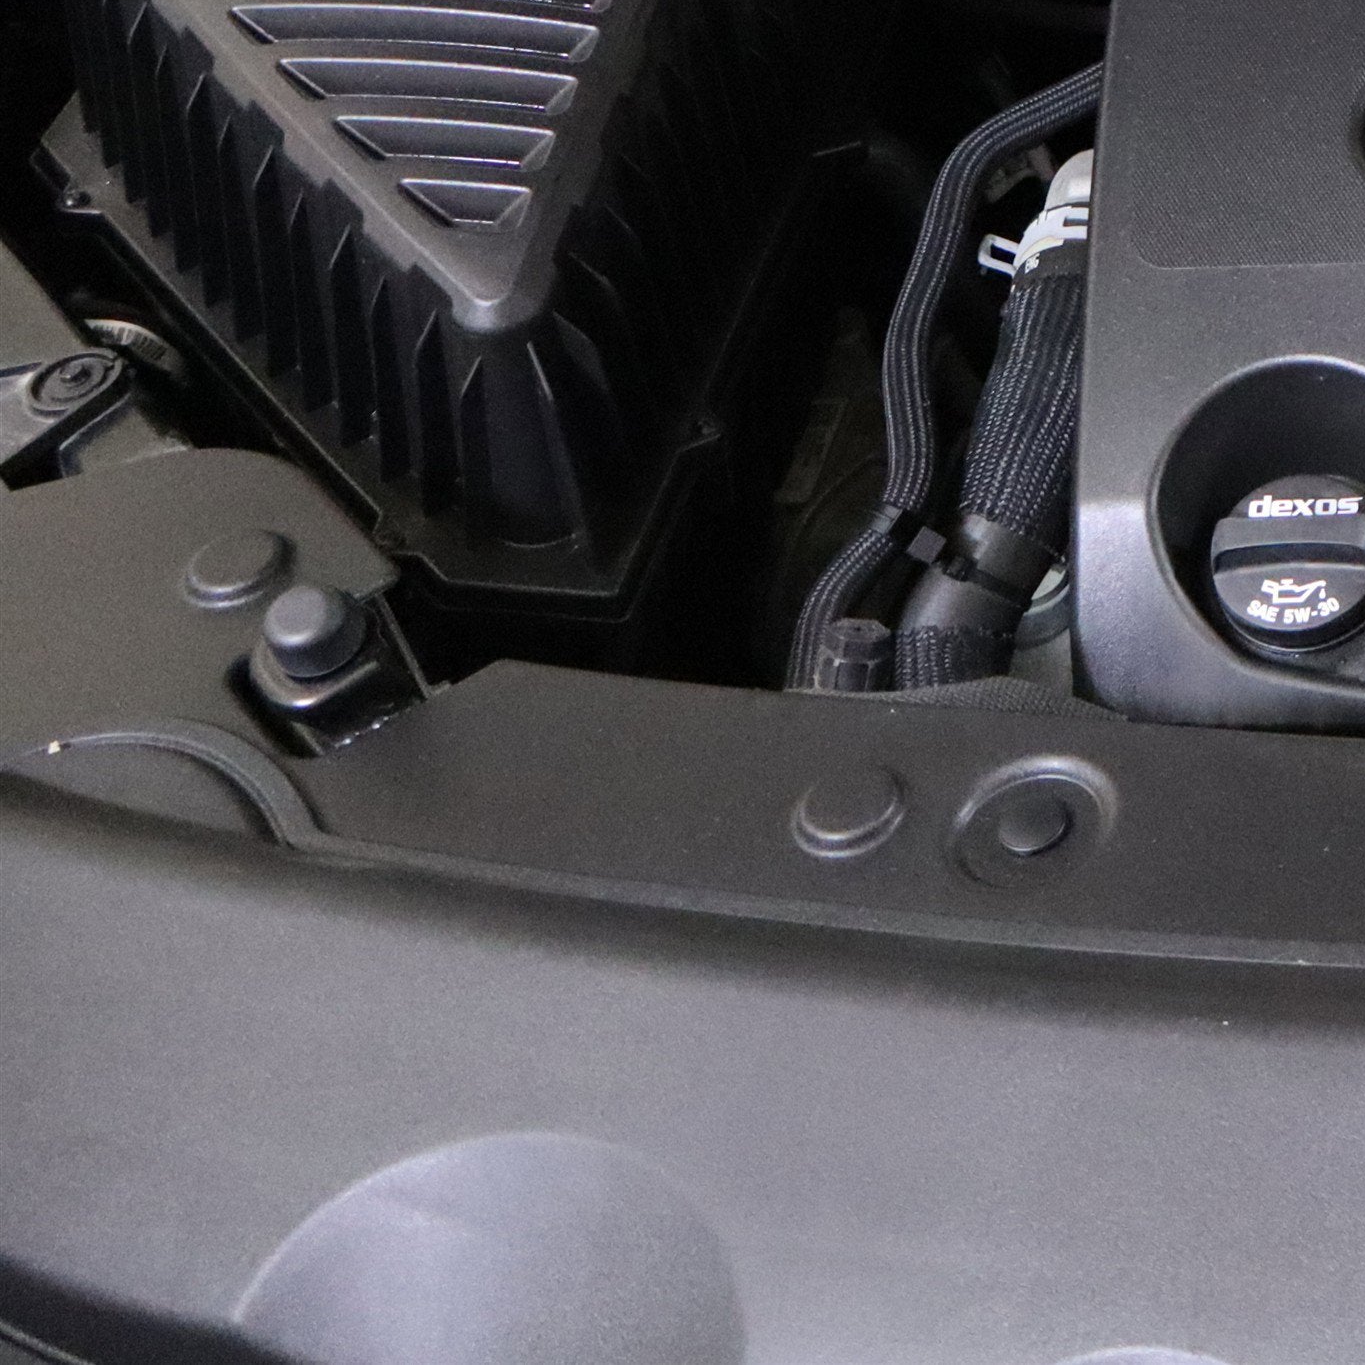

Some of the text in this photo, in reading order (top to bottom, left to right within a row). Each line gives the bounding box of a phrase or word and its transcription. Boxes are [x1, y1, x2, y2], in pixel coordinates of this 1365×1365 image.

[1248, 495, 1363, 517] dexos
[1247, 597, 1340, 623] SAE 5W-30
